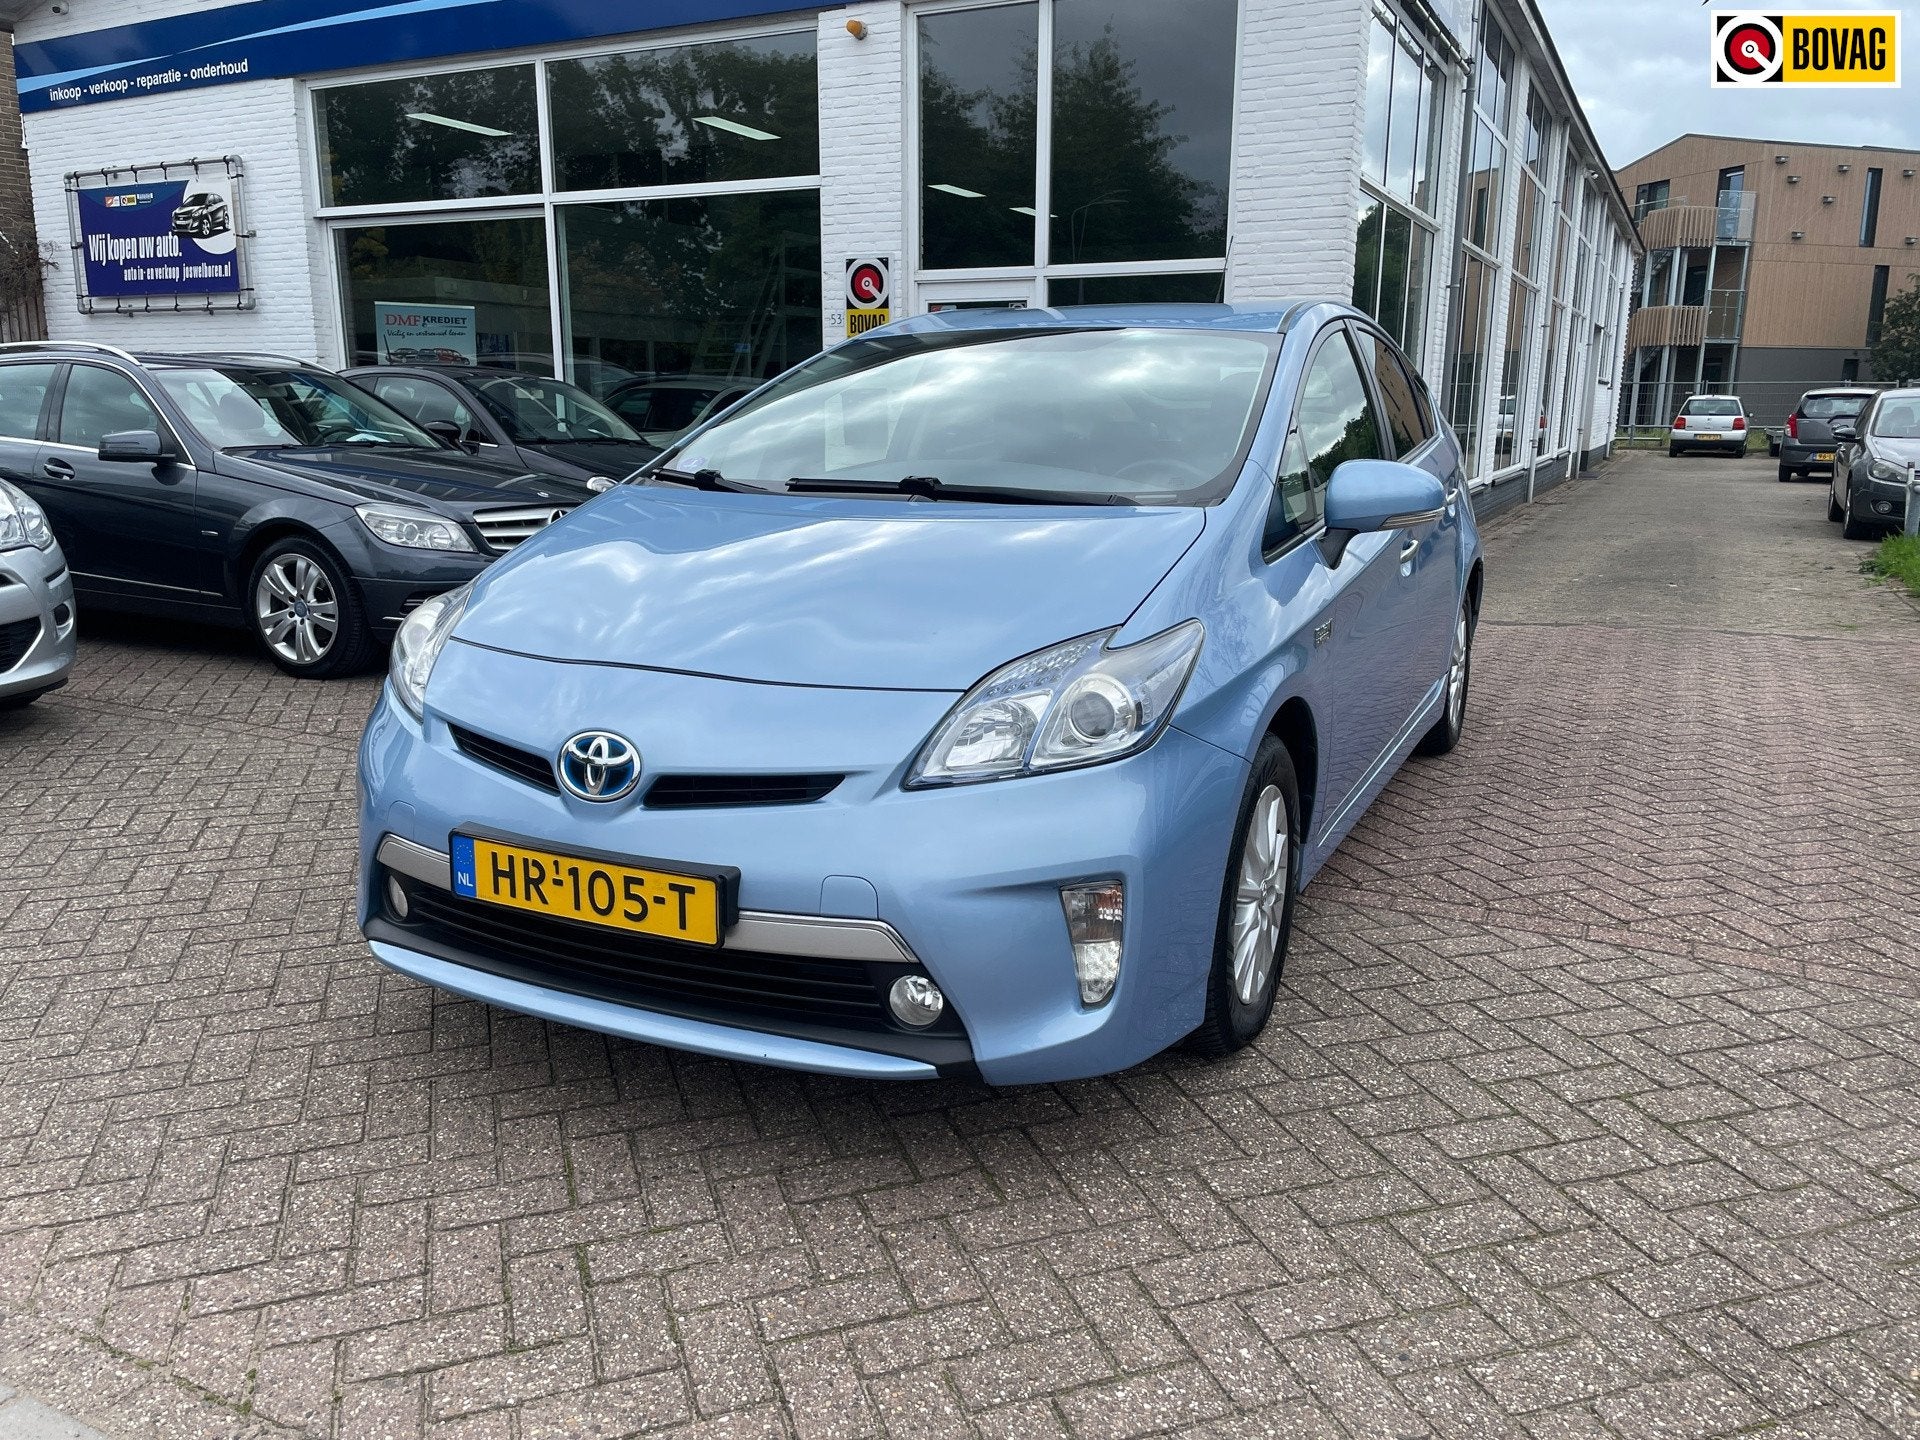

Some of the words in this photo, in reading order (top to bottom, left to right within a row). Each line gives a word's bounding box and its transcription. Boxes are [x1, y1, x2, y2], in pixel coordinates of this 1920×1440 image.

[49, 85, 81, 101] inkoop
[89, 79, 129, 95] verkoop
[136, 69, 181, 89] reparatie
[190, 58, 249, 80] onderhoud
[88, 233, 107, 266] Wij
[107, 233, 138, 265] kopen
[138, 236, 155, 258] uw
[156, 231, 183, 257] auto.
[124, 267, 137, 281] auto
[155, 264, 180, 282] verkoop
[384, 313, 421, 327] DMF
[422, 315, 467, 325] KREDIET
[830, 313, 843, 325] 53
[457, 871, 474, 887] NL
